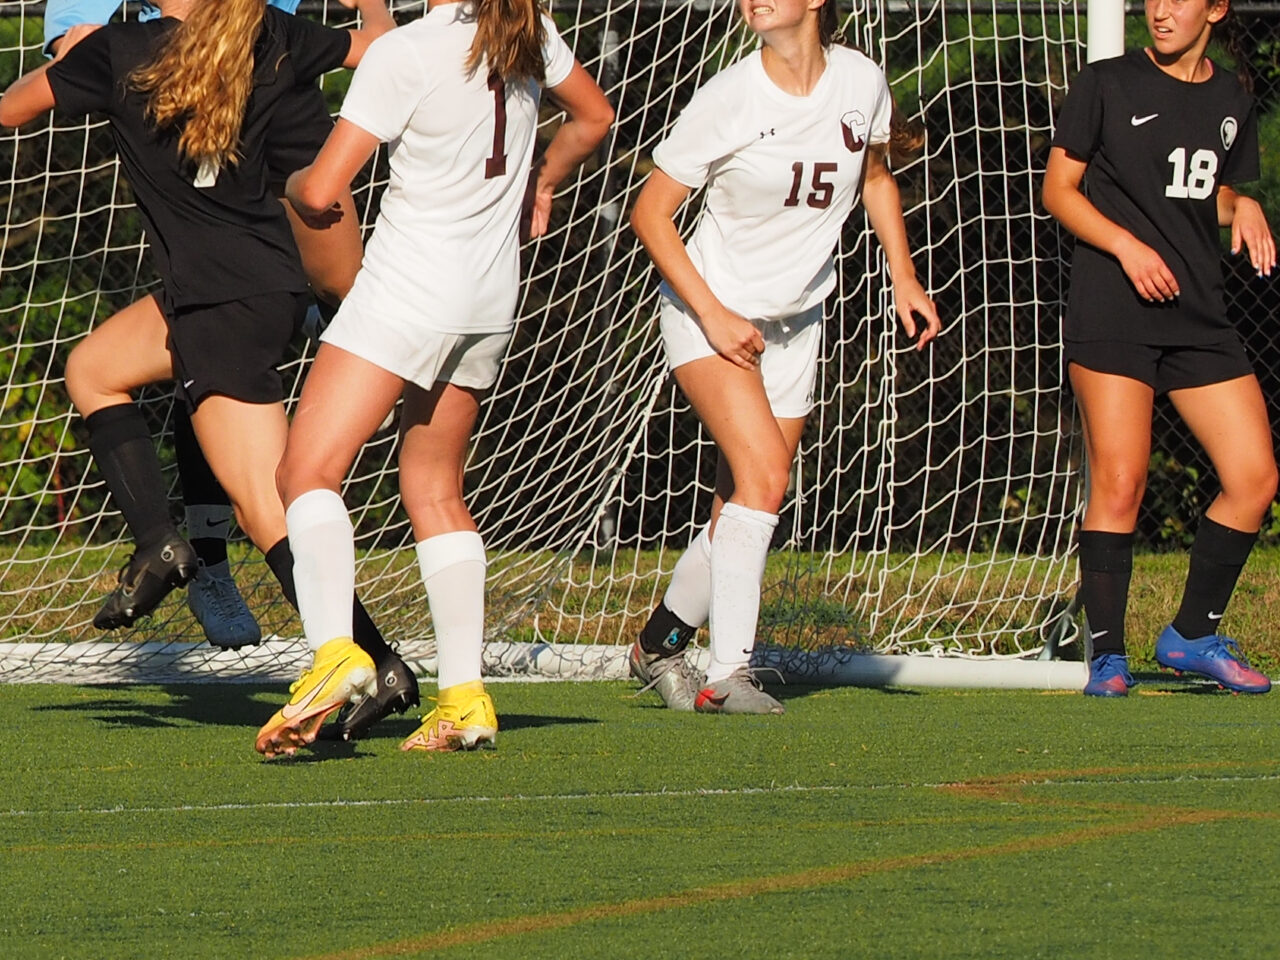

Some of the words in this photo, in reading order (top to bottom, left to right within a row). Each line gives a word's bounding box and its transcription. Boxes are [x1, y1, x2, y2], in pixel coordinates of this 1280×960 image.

[484, 66, 508, 180] 1
[783, 161, 839, 210] 15
[1165, 147, 1218, 200] 18
